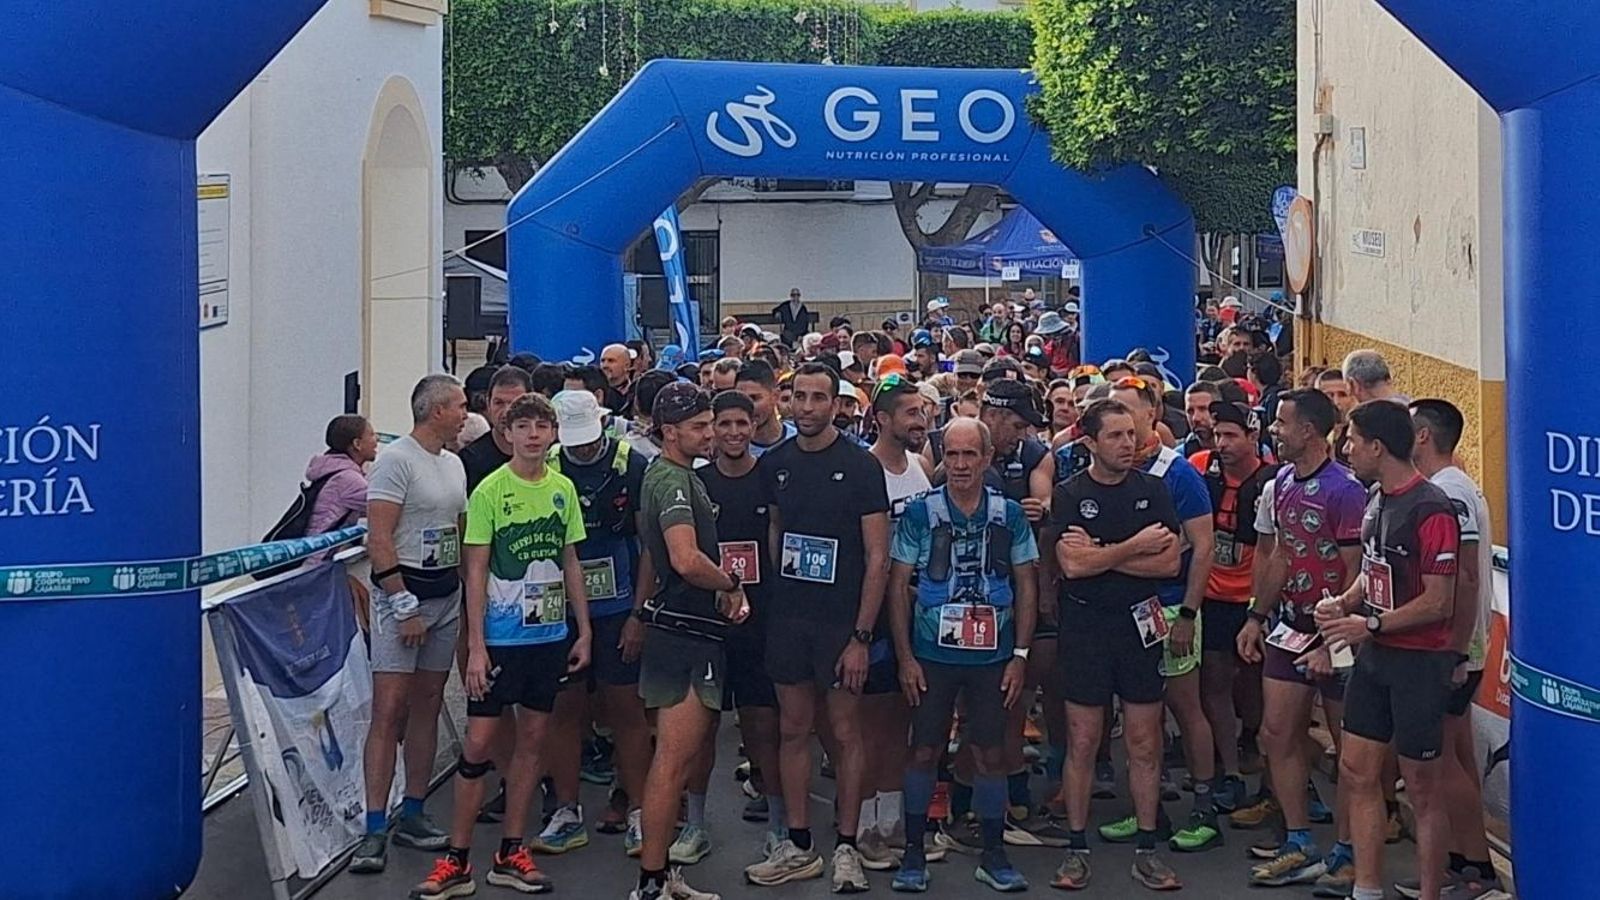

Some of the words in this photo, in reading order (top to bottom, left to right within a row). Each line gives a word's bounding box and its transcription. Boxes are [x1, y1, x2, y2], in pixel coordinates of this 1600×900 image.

[824, 86, 1016, 144] GEO
[825, 149, 905, 162] NUTRICIÓN
[911, 151, 1011, 163] PROFESIONAL
[1362, 230, 1383, 247] MUSEO
[0, 415, 101, 464] IÓN
[1546, 431, 1600, 477] DI
[731, 557, 747, 569] 20
[805, 552, 827, 566] 106
[34, 576, 91, 586] COOPERATIVO
[585, 573, 607, 586] 261
[1373, 578, 1384, 592] 10
[34, 584, 73, 593] CAJAMAR
[972, 621, 986, 634] 16
